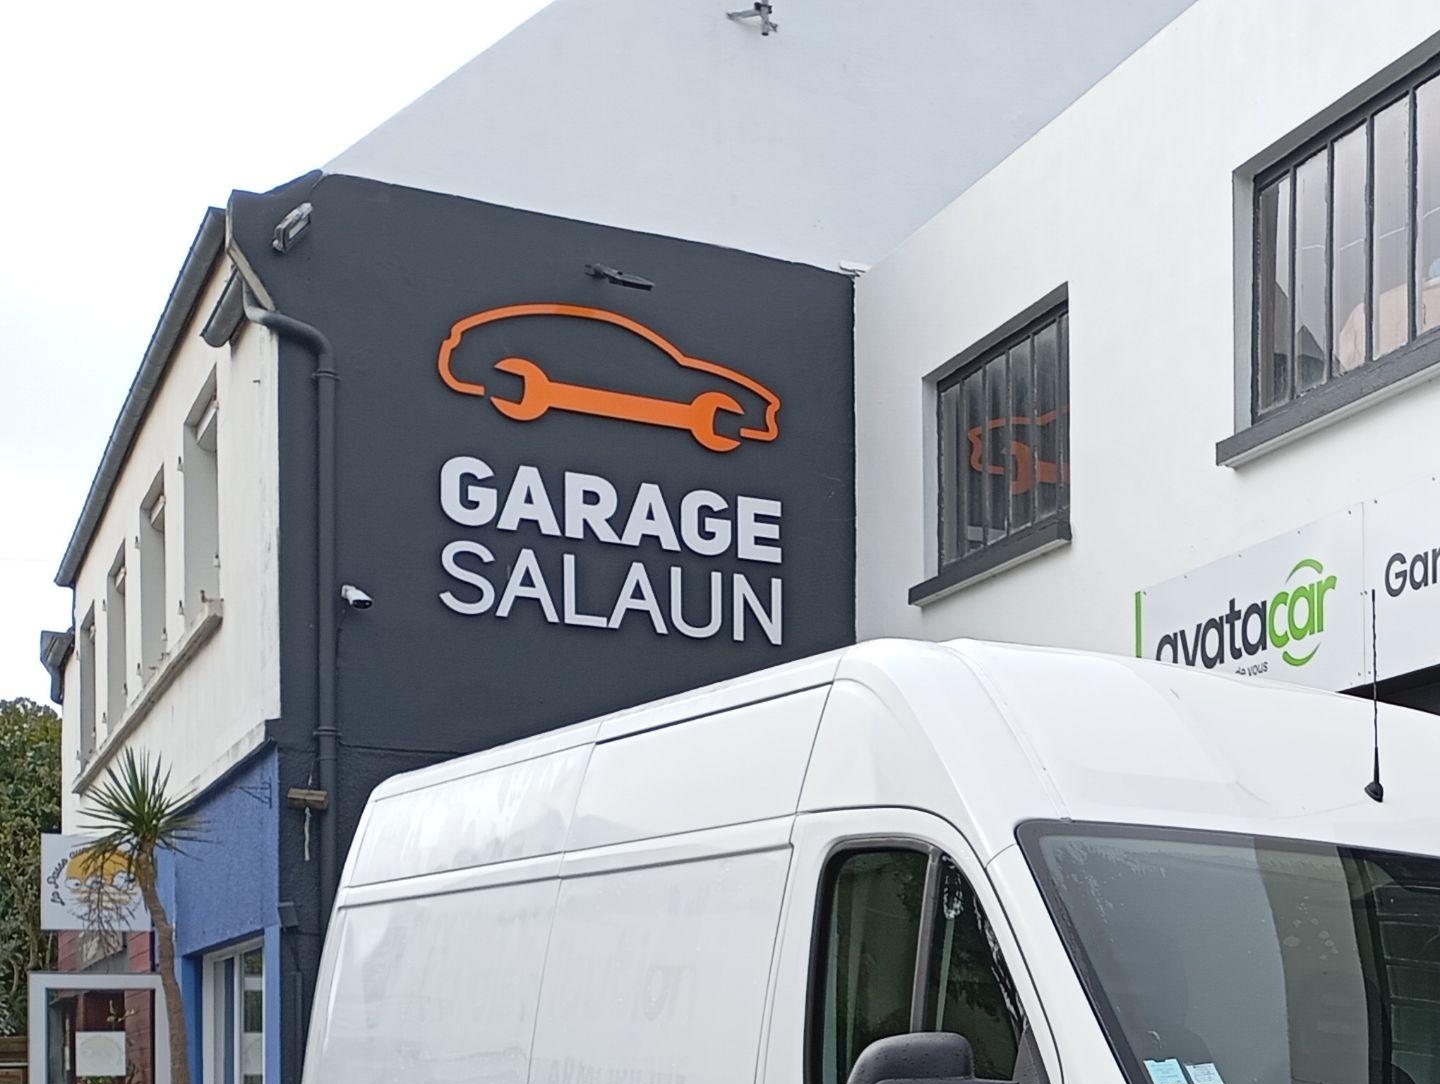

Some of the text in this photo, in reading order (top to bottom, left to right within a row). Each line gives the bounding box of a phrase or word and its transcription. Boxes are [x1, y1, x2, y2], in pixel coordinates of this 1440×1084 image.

[440, 456, 783, 564] GARAGE
[439, 540, 783, 646] SALAUN
[1155, 575, 1338, 669] avatacar
[1247, 661, 1268, 677] vous
